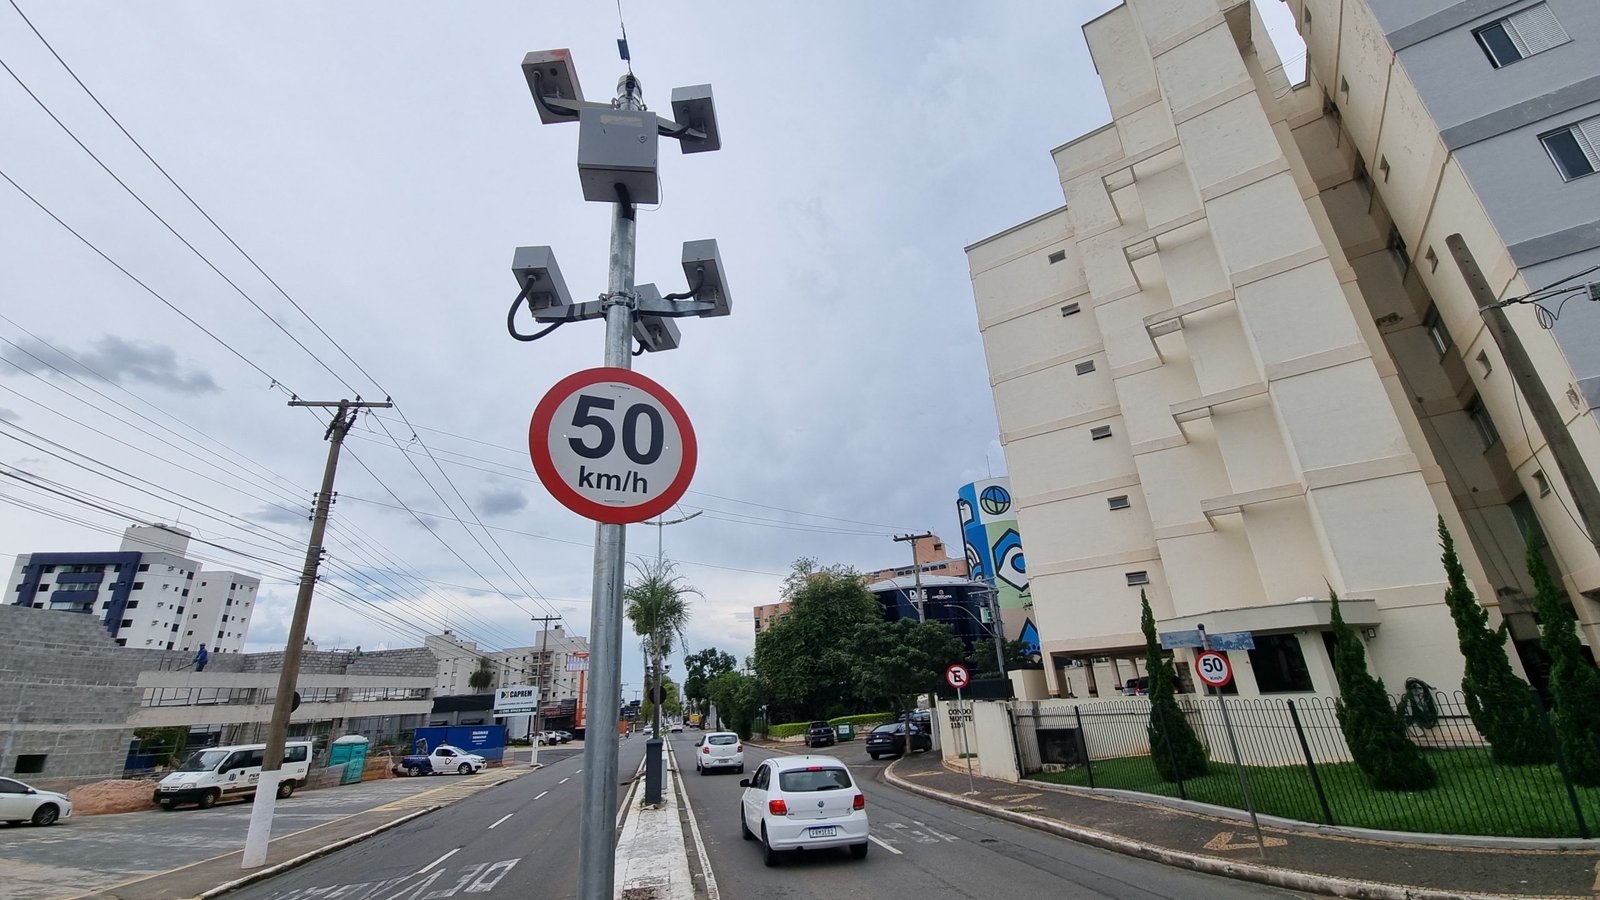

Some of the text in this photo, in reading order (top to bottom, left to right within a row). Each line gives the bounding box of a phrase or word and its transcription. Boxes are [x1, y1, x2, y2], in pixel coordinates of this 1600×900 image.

[568, 394, 664, 465] 50
[578, 465, 648, 494] km/h
[909, 588, 927, 598] DE
[1202, 657, 1223, 673] 50
[510, 690, 533, 698] CAPREM
